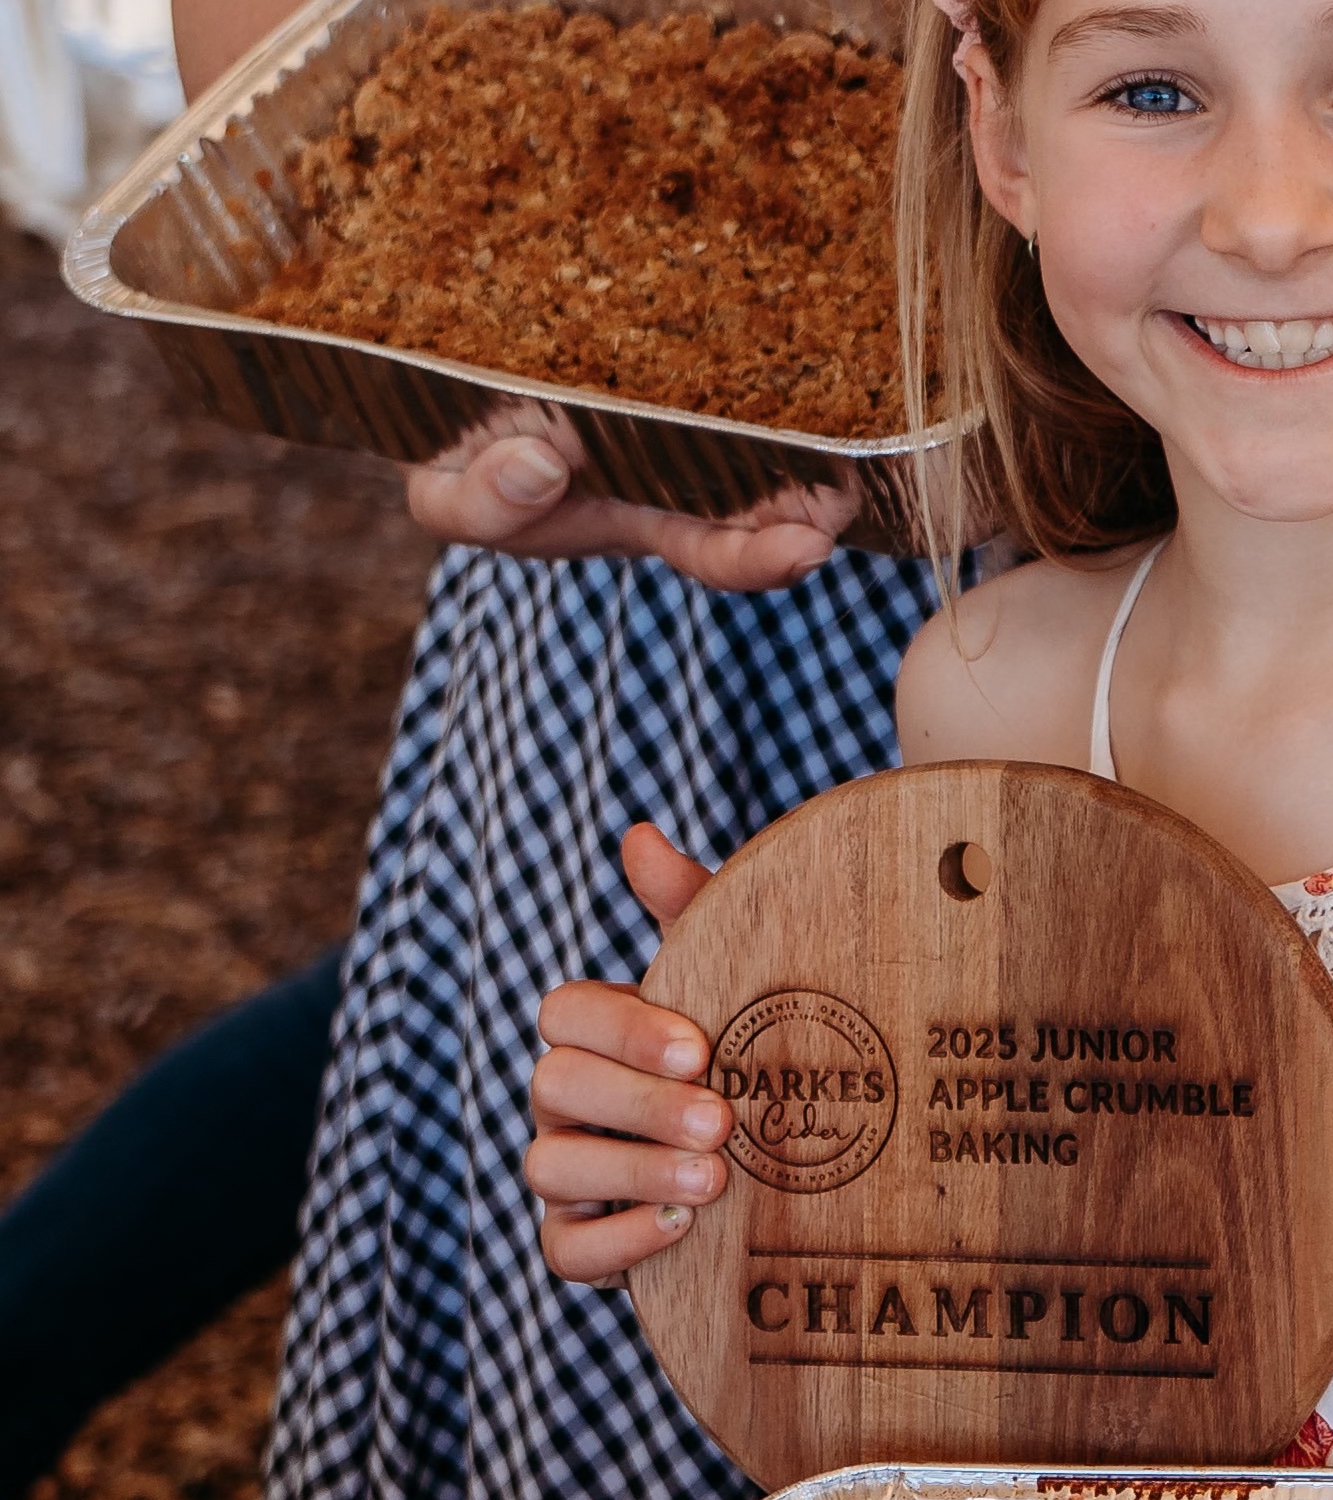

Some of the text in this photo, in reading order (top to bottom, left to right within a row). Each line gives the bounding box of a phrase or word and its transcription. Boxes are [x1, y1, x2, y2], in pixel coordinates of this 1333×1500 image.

[820, 1004, 876, 1055] ORCHARD
[927, 1026, 1178, 1064] 2025 JUNIOR
[721, 1067, 886, 1103] DARKES
[928, 1078, 1256, 1118] APPLE CRUMBLE
[760, 1100, 850, 1146] Cider
[732, 1126, 757, 1162] RUIT
[929, 1130, 1079, 1167] BAKING
[745, 1279, 1215, 1347] CHAMPION
